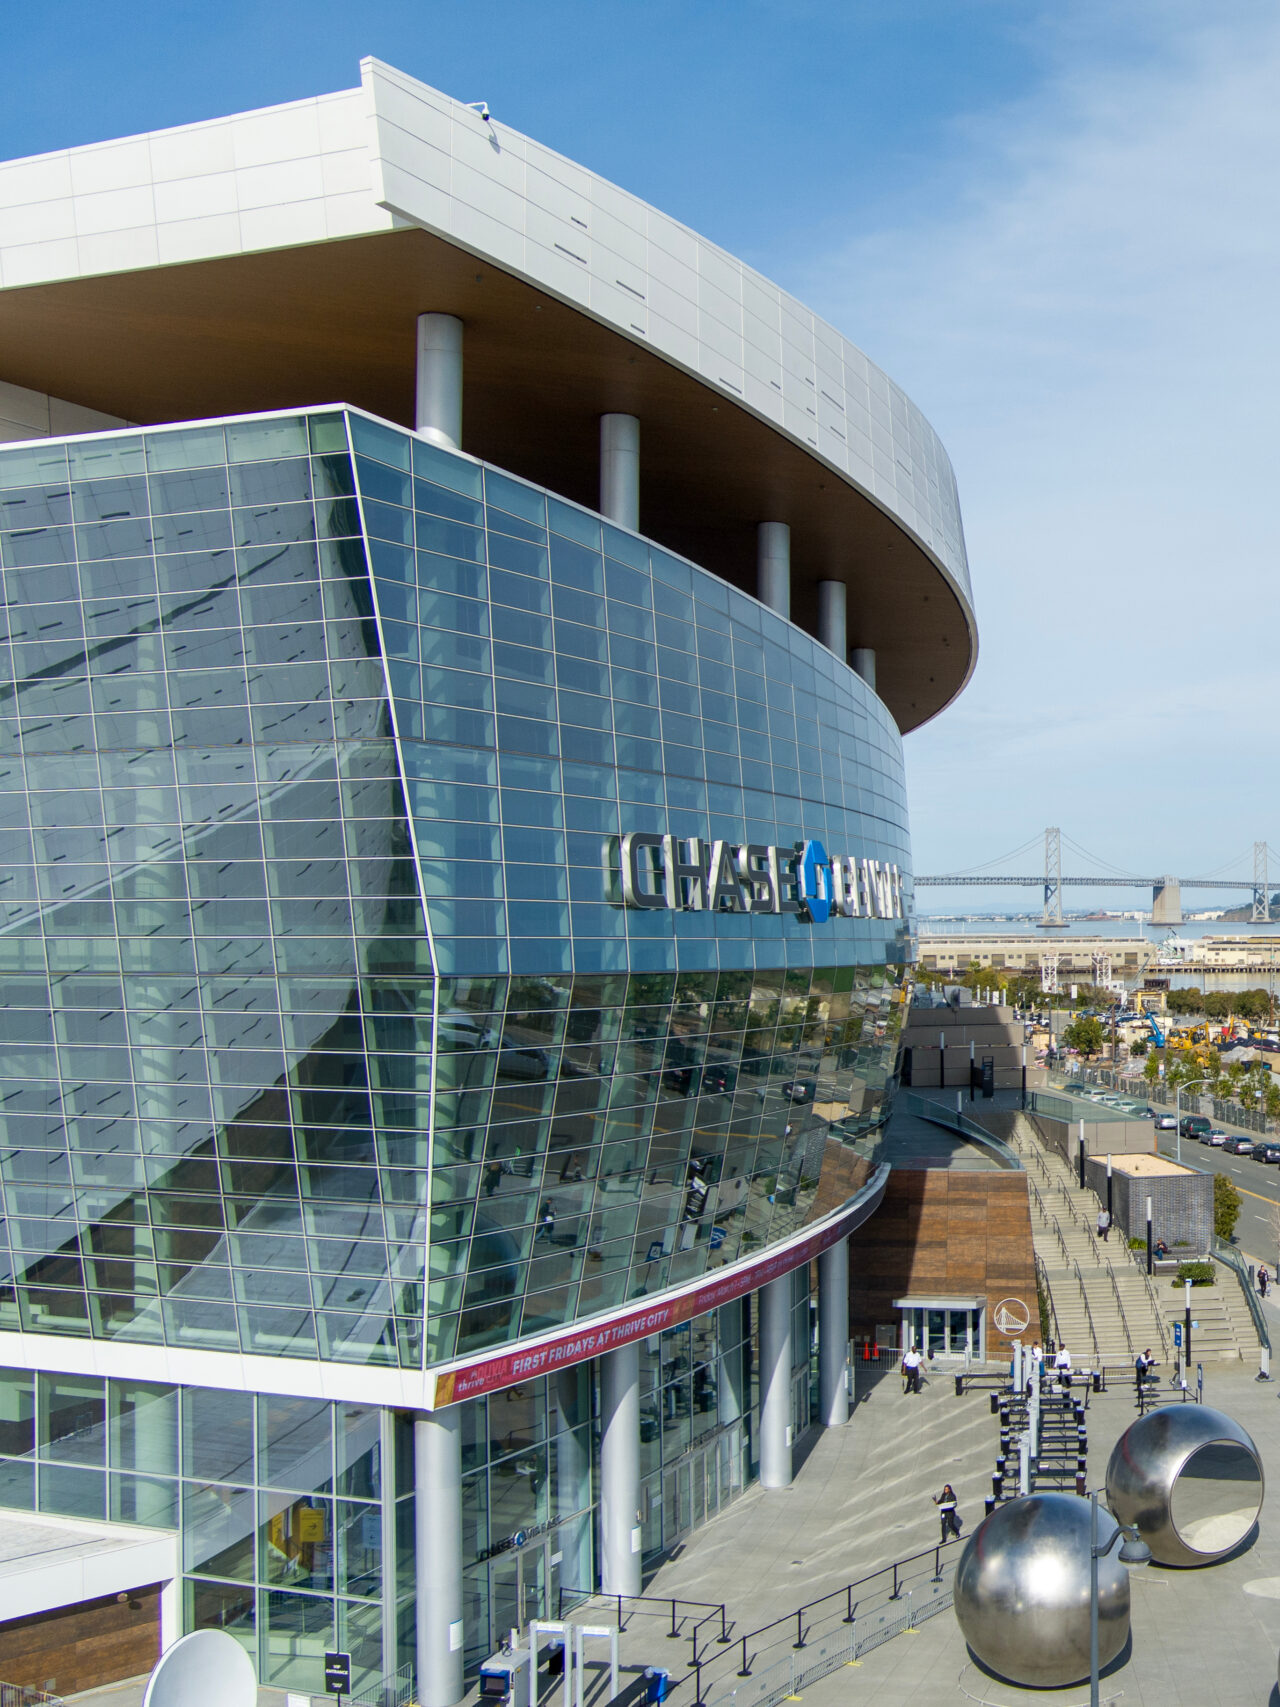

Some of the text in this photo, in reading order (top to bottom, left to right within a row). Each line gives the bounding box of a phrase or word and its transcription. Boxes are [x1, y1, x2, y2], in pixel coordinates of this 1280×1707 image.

[622, 832, 800, 914] CHASE
[512, 1309, 669, 1375] FIRST FRIDAYS AT THRIVE CITY
[458, 1377, 485, 1392] thrive
